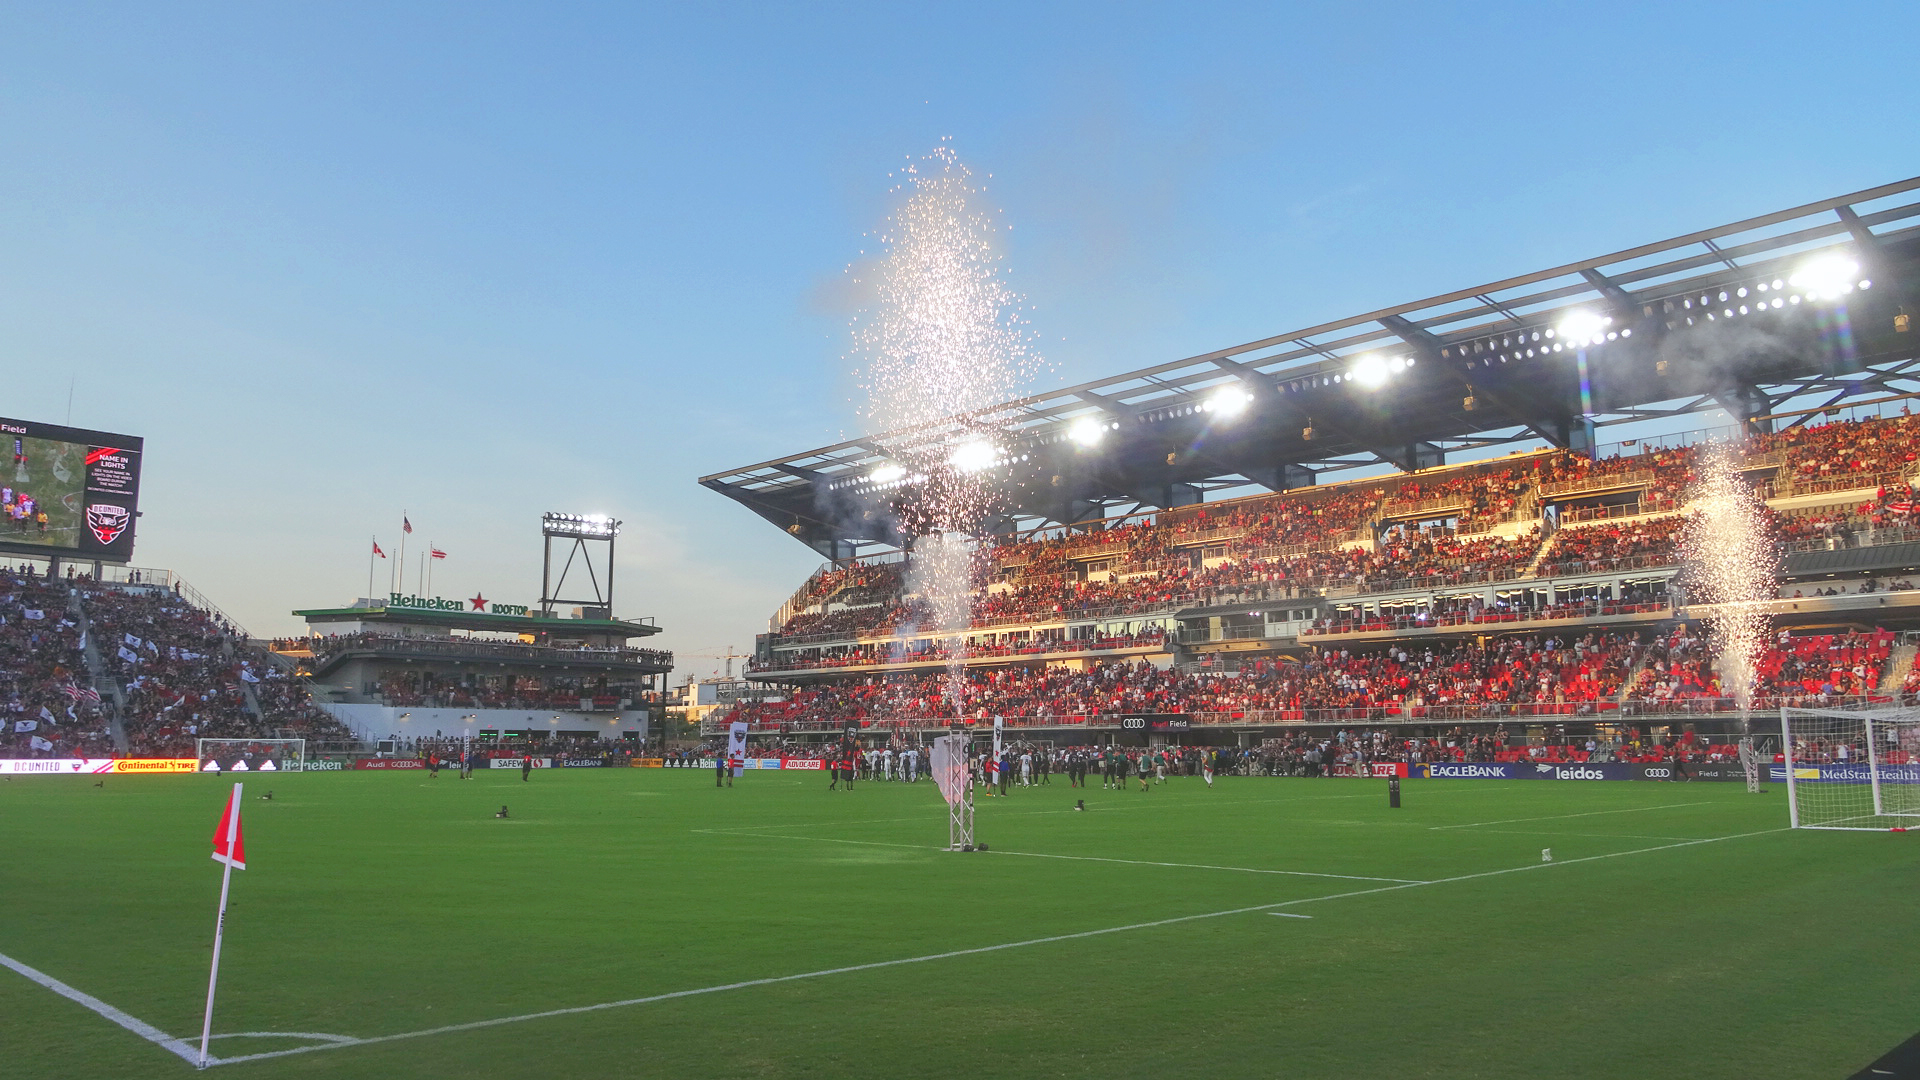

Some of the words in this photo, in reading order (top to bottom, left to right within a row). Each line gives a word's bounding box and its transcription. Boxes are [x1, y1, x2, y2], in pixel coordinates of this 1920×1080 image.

[1, 424, 27, 434] Field
[99, 454, 120, 463] NAME
[100, 461, 126, 470] LIGHTS
[389, 592, 464, 611] Heineken
[492, 604, 528, 616] ROOFTOP
[28, 762, 60, 771] UNITED
[118, 761, 168, 771] Continental
[281, 760, 342, 771] Heneken
[1430, 765, 1506, 777] EAGLEBANK
[1556, 766, 1604, 780] leidos
[1822, 770, 1872, 779] MedStar
[1876, 770, 1918, 780] Health
